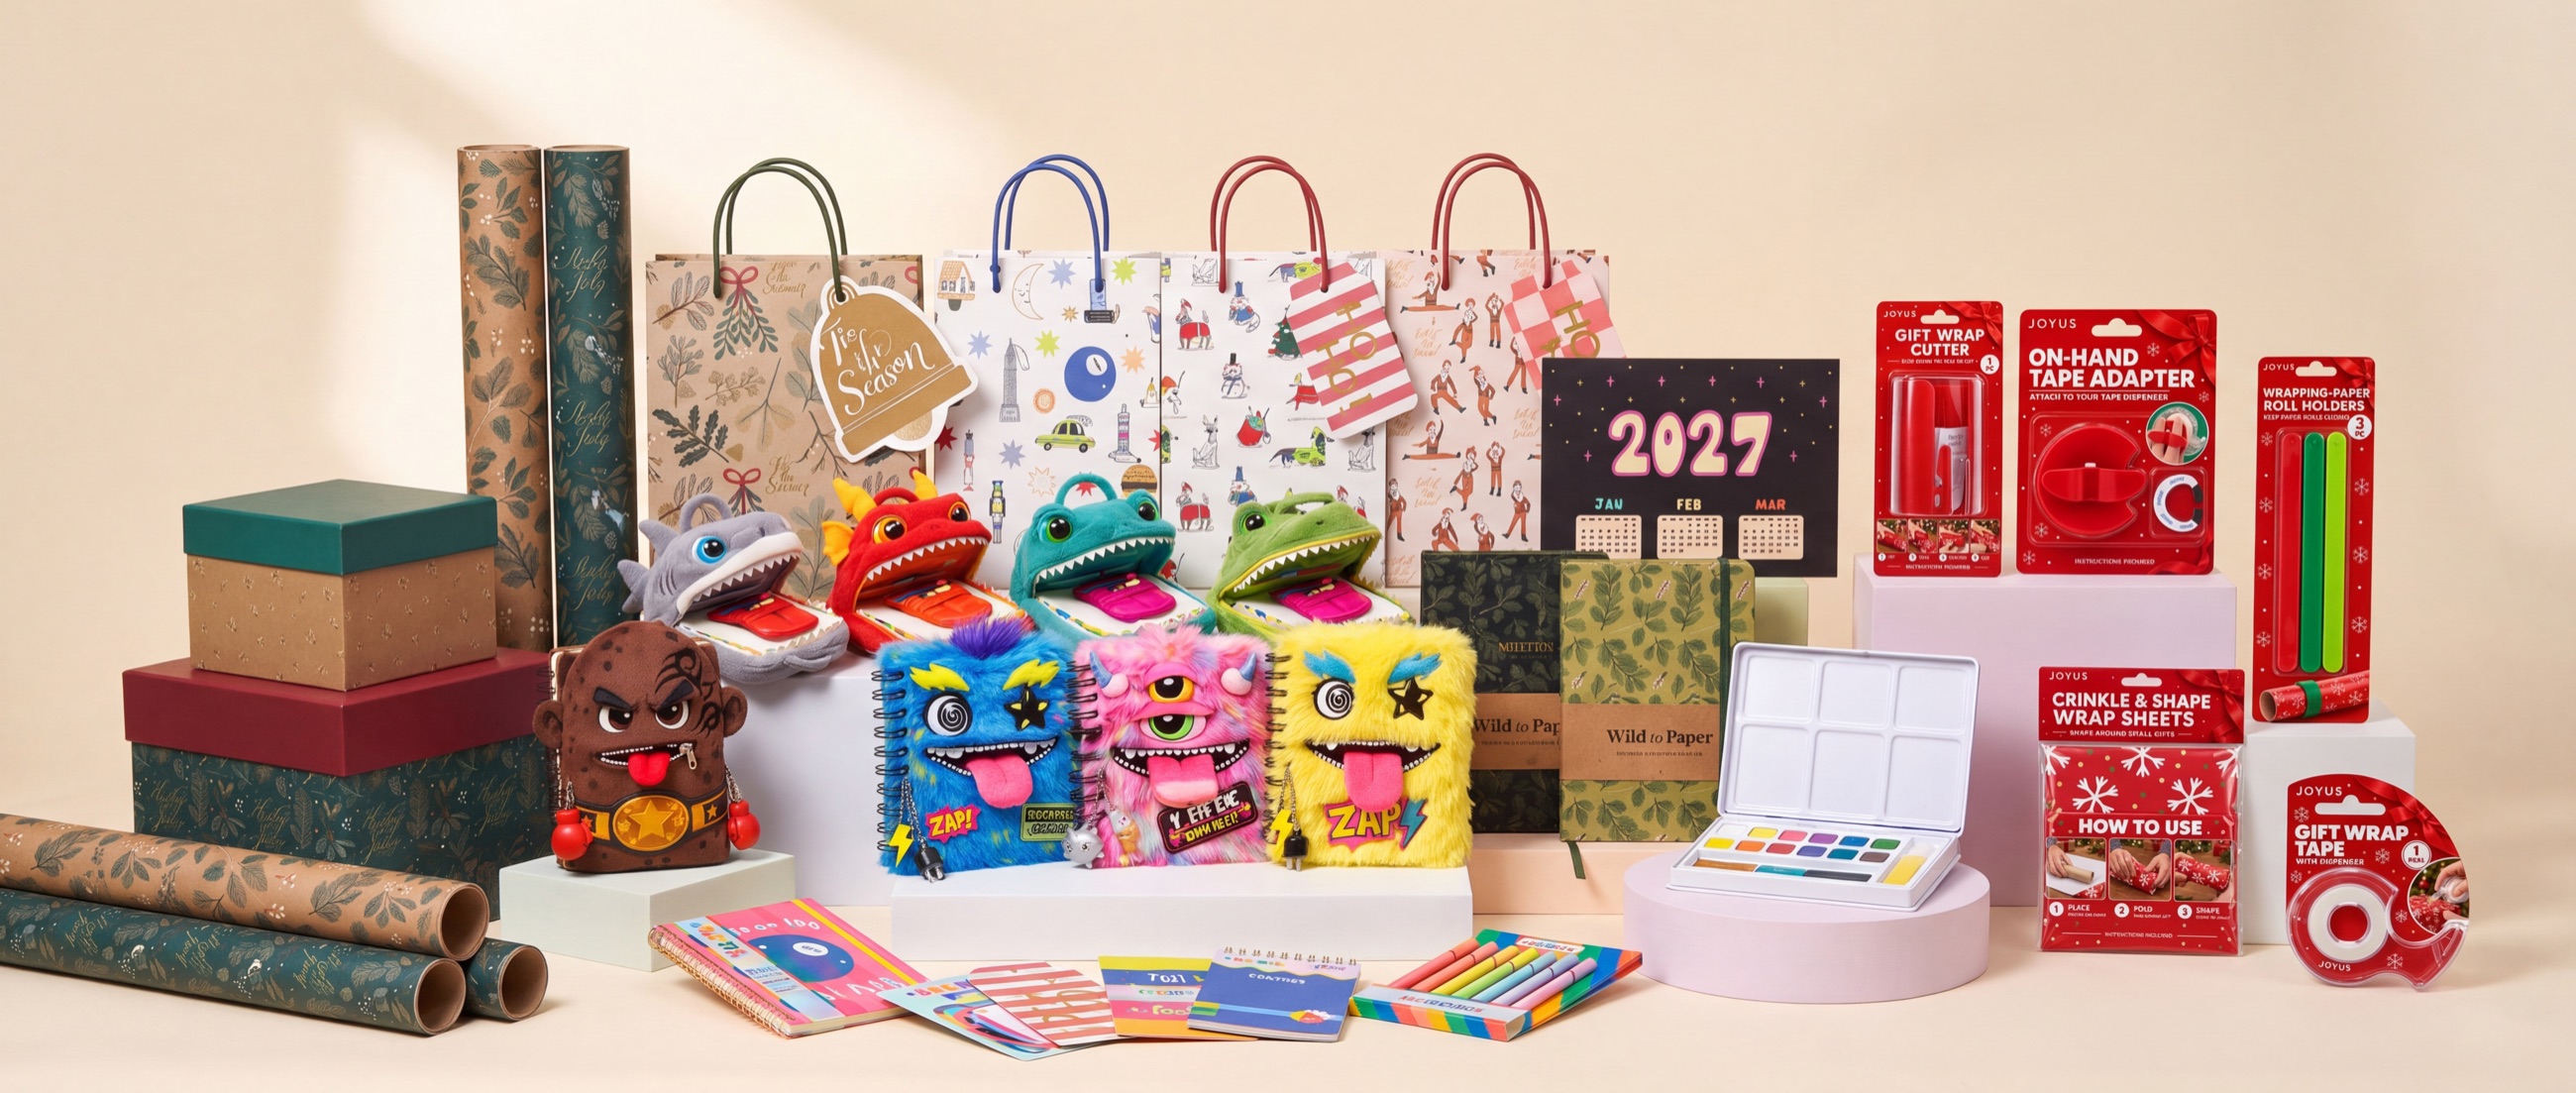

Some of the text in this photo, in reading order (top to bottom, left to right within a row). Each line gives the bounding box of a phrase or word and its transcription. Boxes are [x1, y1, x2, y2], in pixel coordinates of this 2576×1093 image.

[2028, 318, 2077, 329] JOYUS
[1894, 329, 1986, 342] GIFT WRAP
[1910, 343, 1970, 357] CUTTER
[1987, 357, 1992, 366] 1
[2029, 348, 2139, 367] ON-HAND
[2263, 363, 2296, 372] JOYUS
[838, 342, 936, 416] Season
[2029, 369, 2196, 388] TAPE ADAPTER
[2263, 387, 2371, 398] WRAPPING-PAPER
[2264, 400, 2366, 411] ROLL HOLDERS
[2356, 416, 2365, 430] 3
[1608, 409, 1772, 477] 2027
[1595, 497, 1623, 510] JAN
[1676, 498, 1702, 510] FEB
[1756, 498, 1786, 510] MAR
[2049, 671, 2088, 681] JOYUS
[2052, 692, 2211, 710] CRINKLE & SHAPE
[2053, 710, 2195, 727] WRAP SHEETS
[1474, 718, 1512, 733] Wild
[1516, 721, 1529, 733] to
[1606, 728, 1714, 747] Wild to Paper
[2296, 786, 2342, 797] JOYUS
[929, 809, 972, 837] ZAP!
[1328, 800, 1402, 839] ZAP
[2079, 819, 2202, 836] HOW TO USE
[2295, 823, 2409, 841] GIFT WRAP
[2295, 840, 2345, 857] TAPE
[2413, 844, 2419, 856] 1
[2054, 904, 2059, 914] 1
[2119, 906, 2125, 915] 2
[2182, 908, 2189, 917] 3
[2317, 960, 2351, 972] JOYUS
